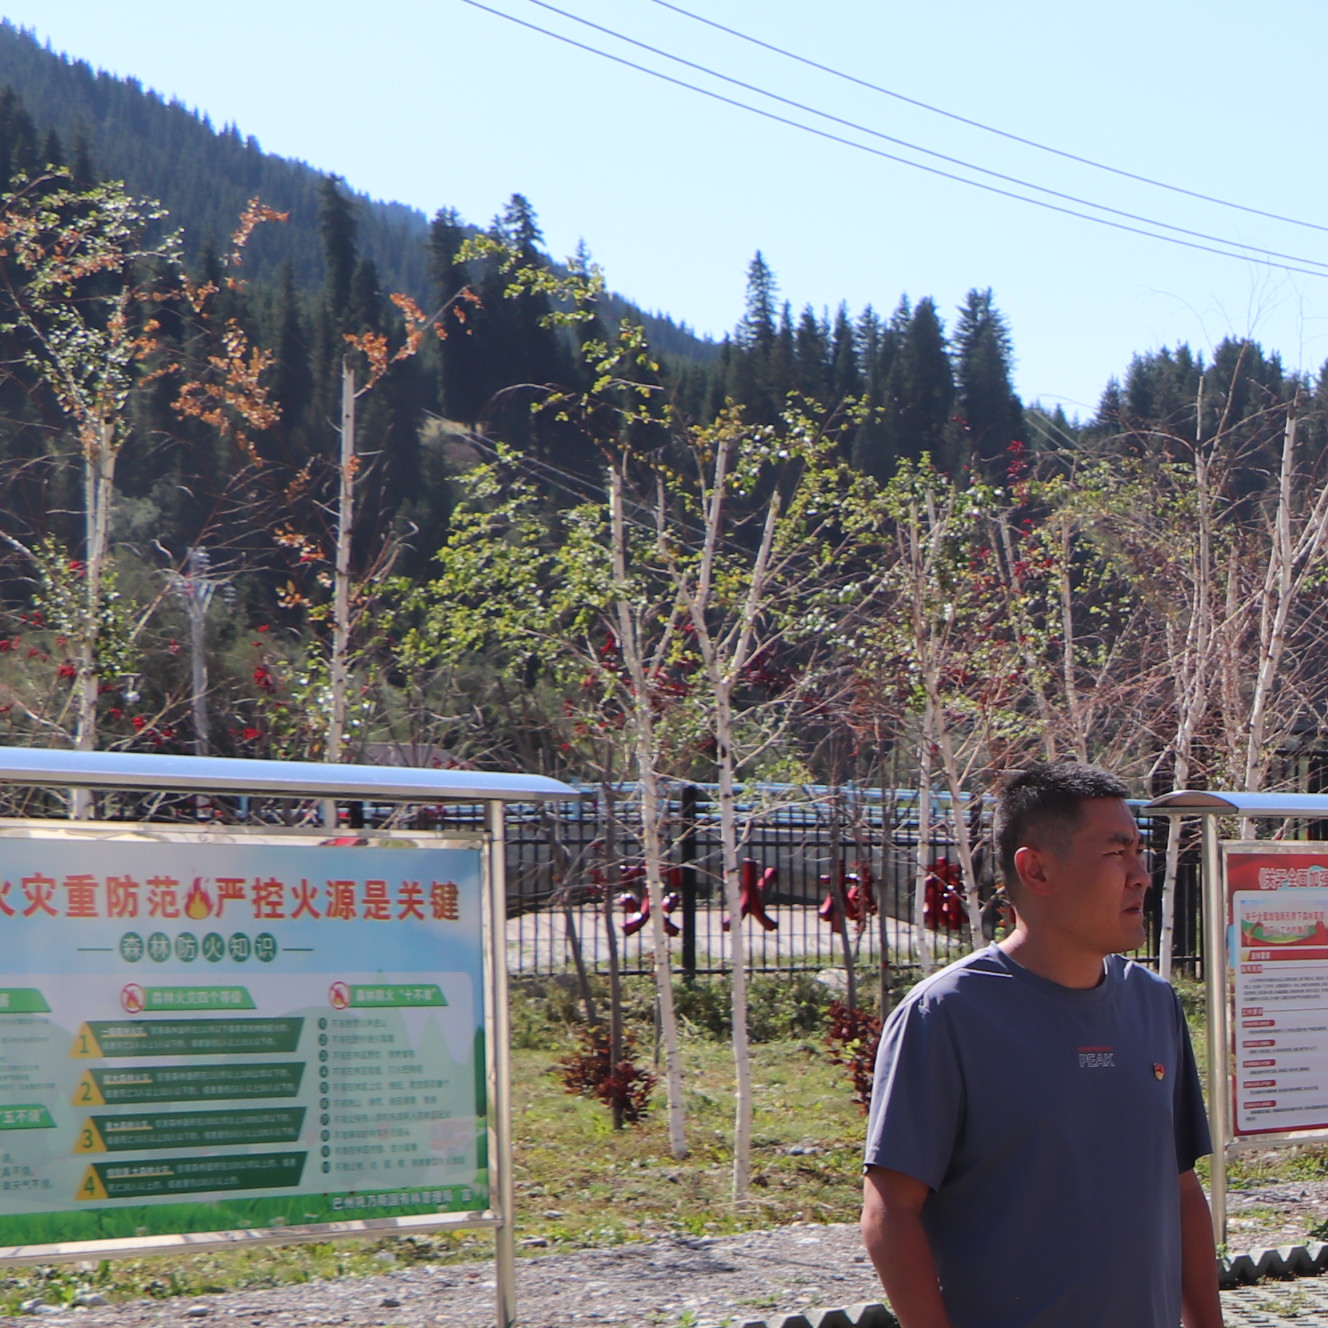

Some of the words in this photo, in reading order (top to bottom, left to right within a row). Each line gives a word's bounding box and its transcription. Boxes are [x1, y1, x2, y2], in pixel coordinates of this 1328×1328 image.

[213, 876, 460, 922] 严控火源是关键
[121, 933, 276, 961] 森林防火知识
[79, 1034, 90, 1054] 1
[1078, 1052, 1116, 1068] PEAK
[81, 1081, 92, 1102] 2
[83, 1129, 94, 1149] 3
[84, 1175, 95, 1196] 4
